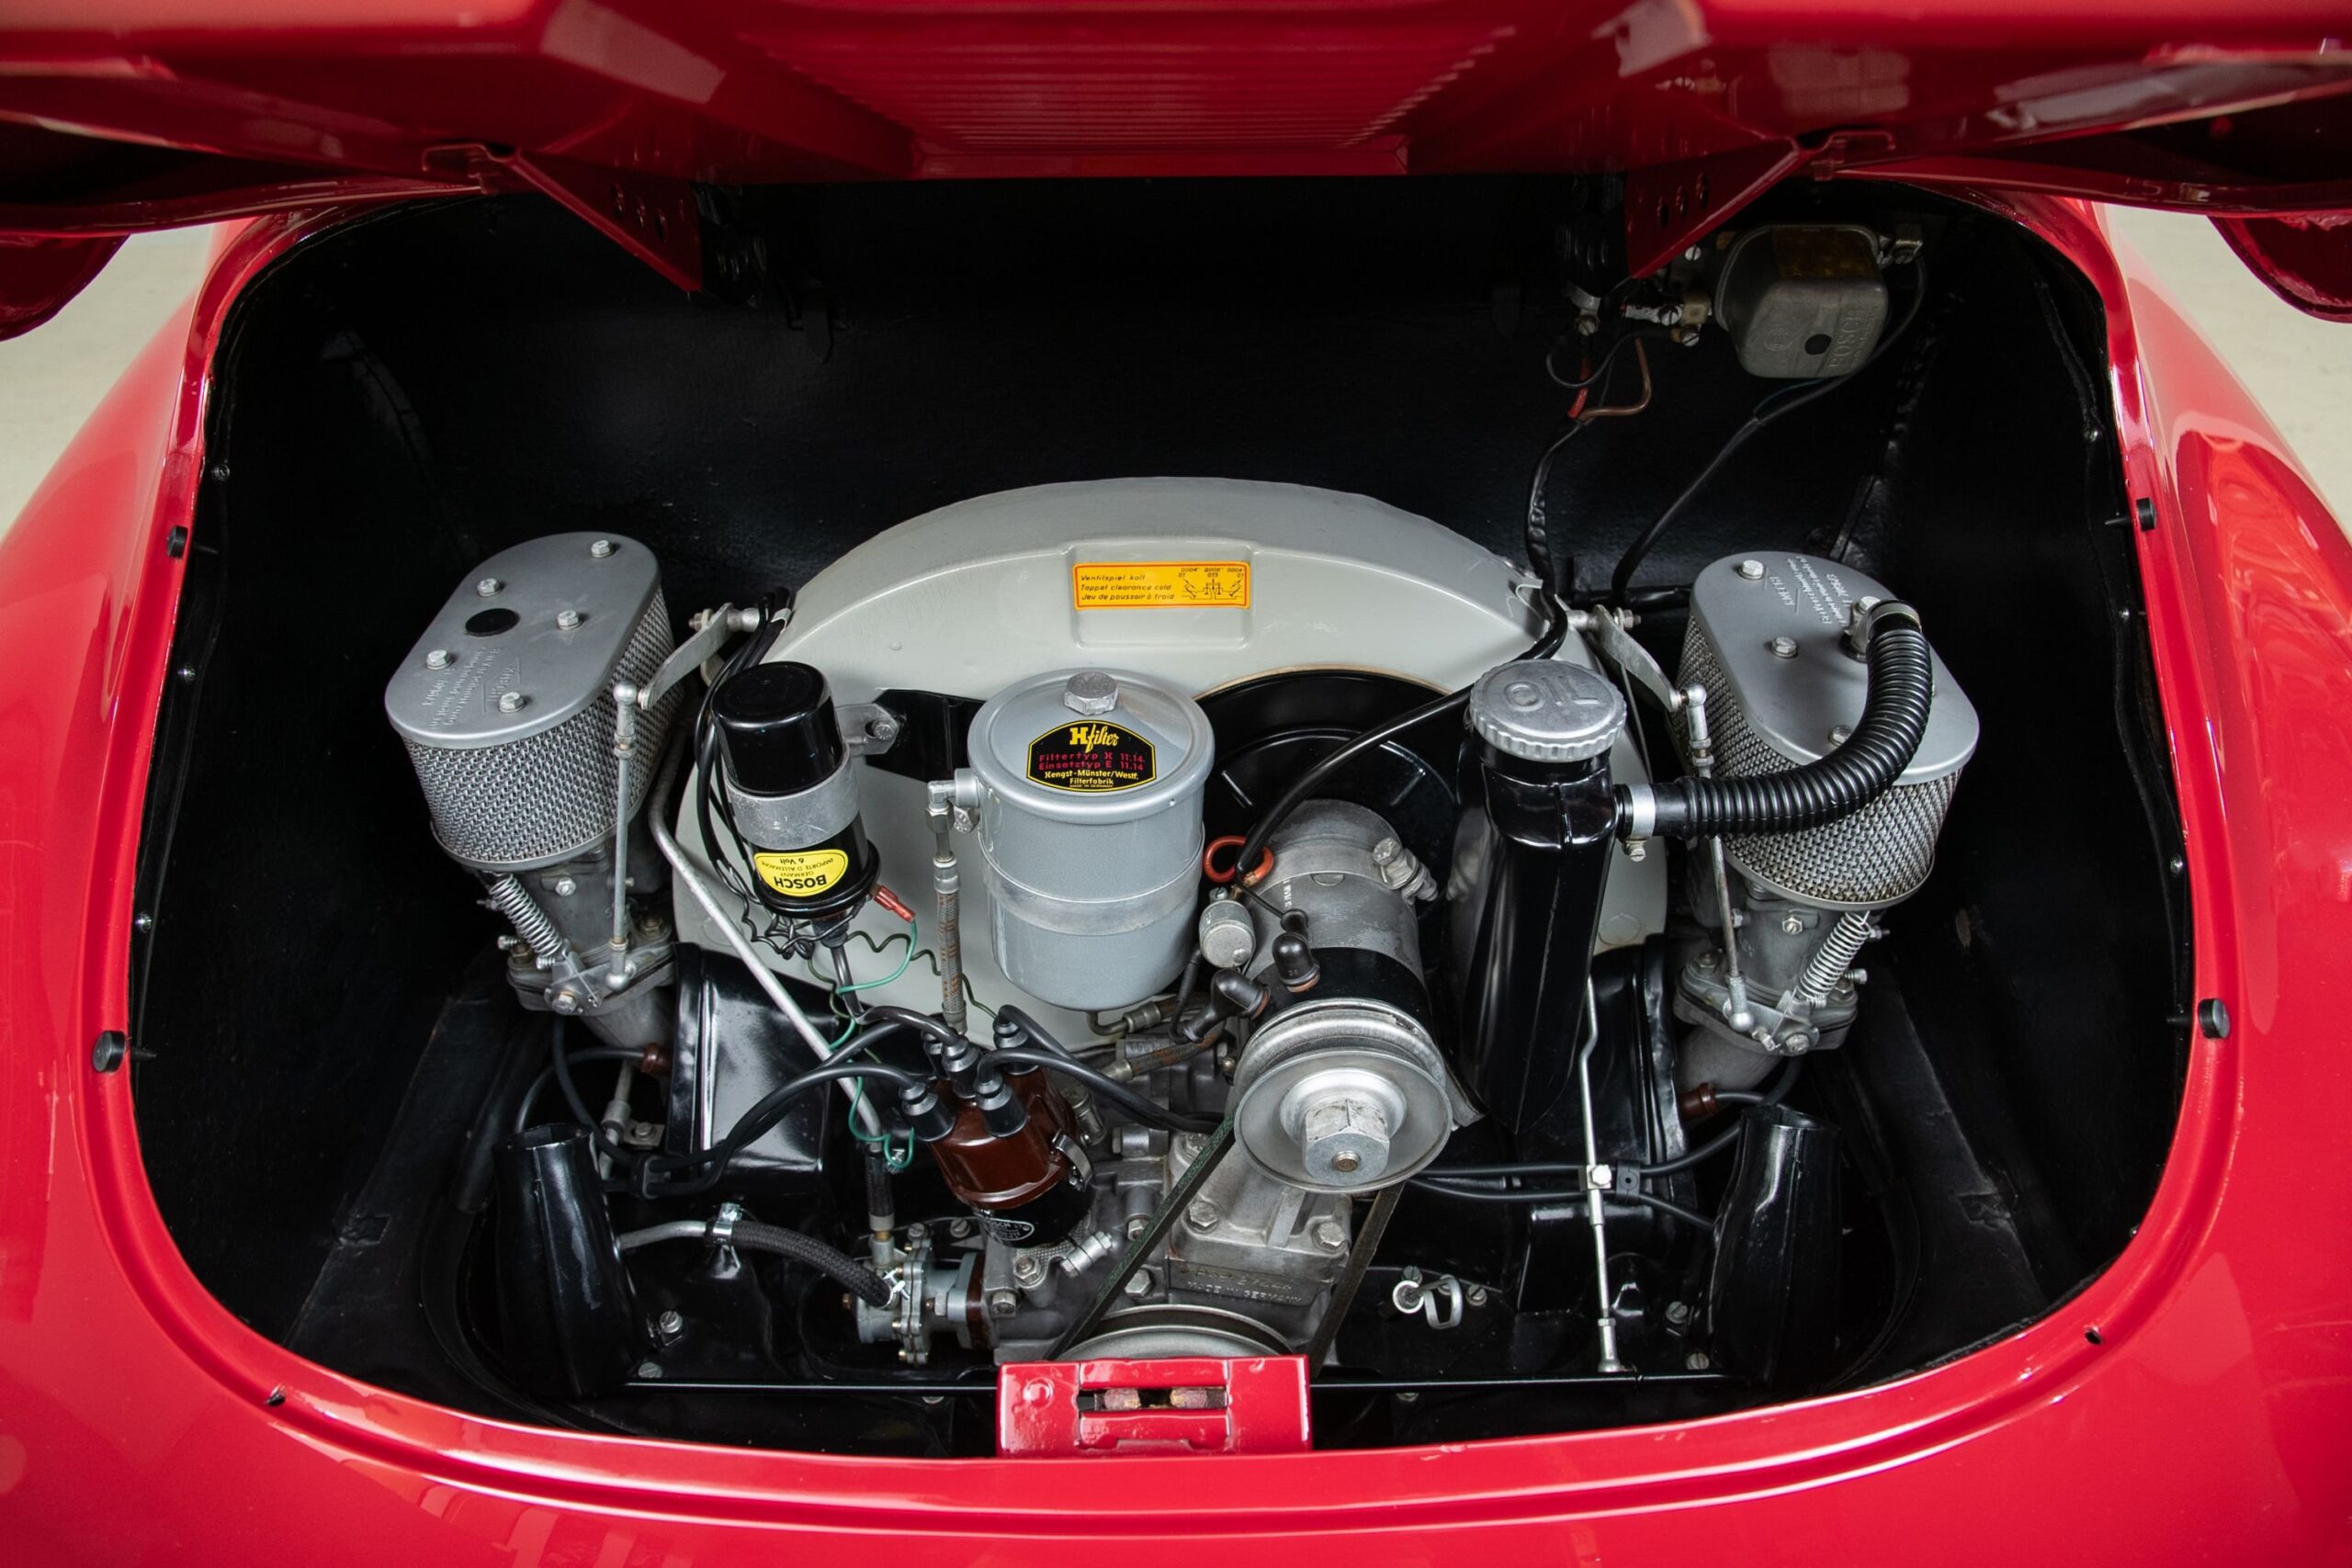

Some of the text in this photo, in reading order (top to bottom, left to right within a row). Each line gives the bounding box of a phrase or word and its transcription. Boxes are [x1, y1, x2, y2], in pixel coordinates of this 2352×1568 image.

[1080, 583, 1108, 592] Tappet
[1503, 675, 1600, 713] OIL
[1038, 752, 1099, 762] Filtertyp
[1038, 761, 1102, 771] Einsatztyp
[1105, 760, 1113, 768] E
[1069, 777, 1114, 785] Filterfabrik
[774, 874, 828, 889] BOSCH
